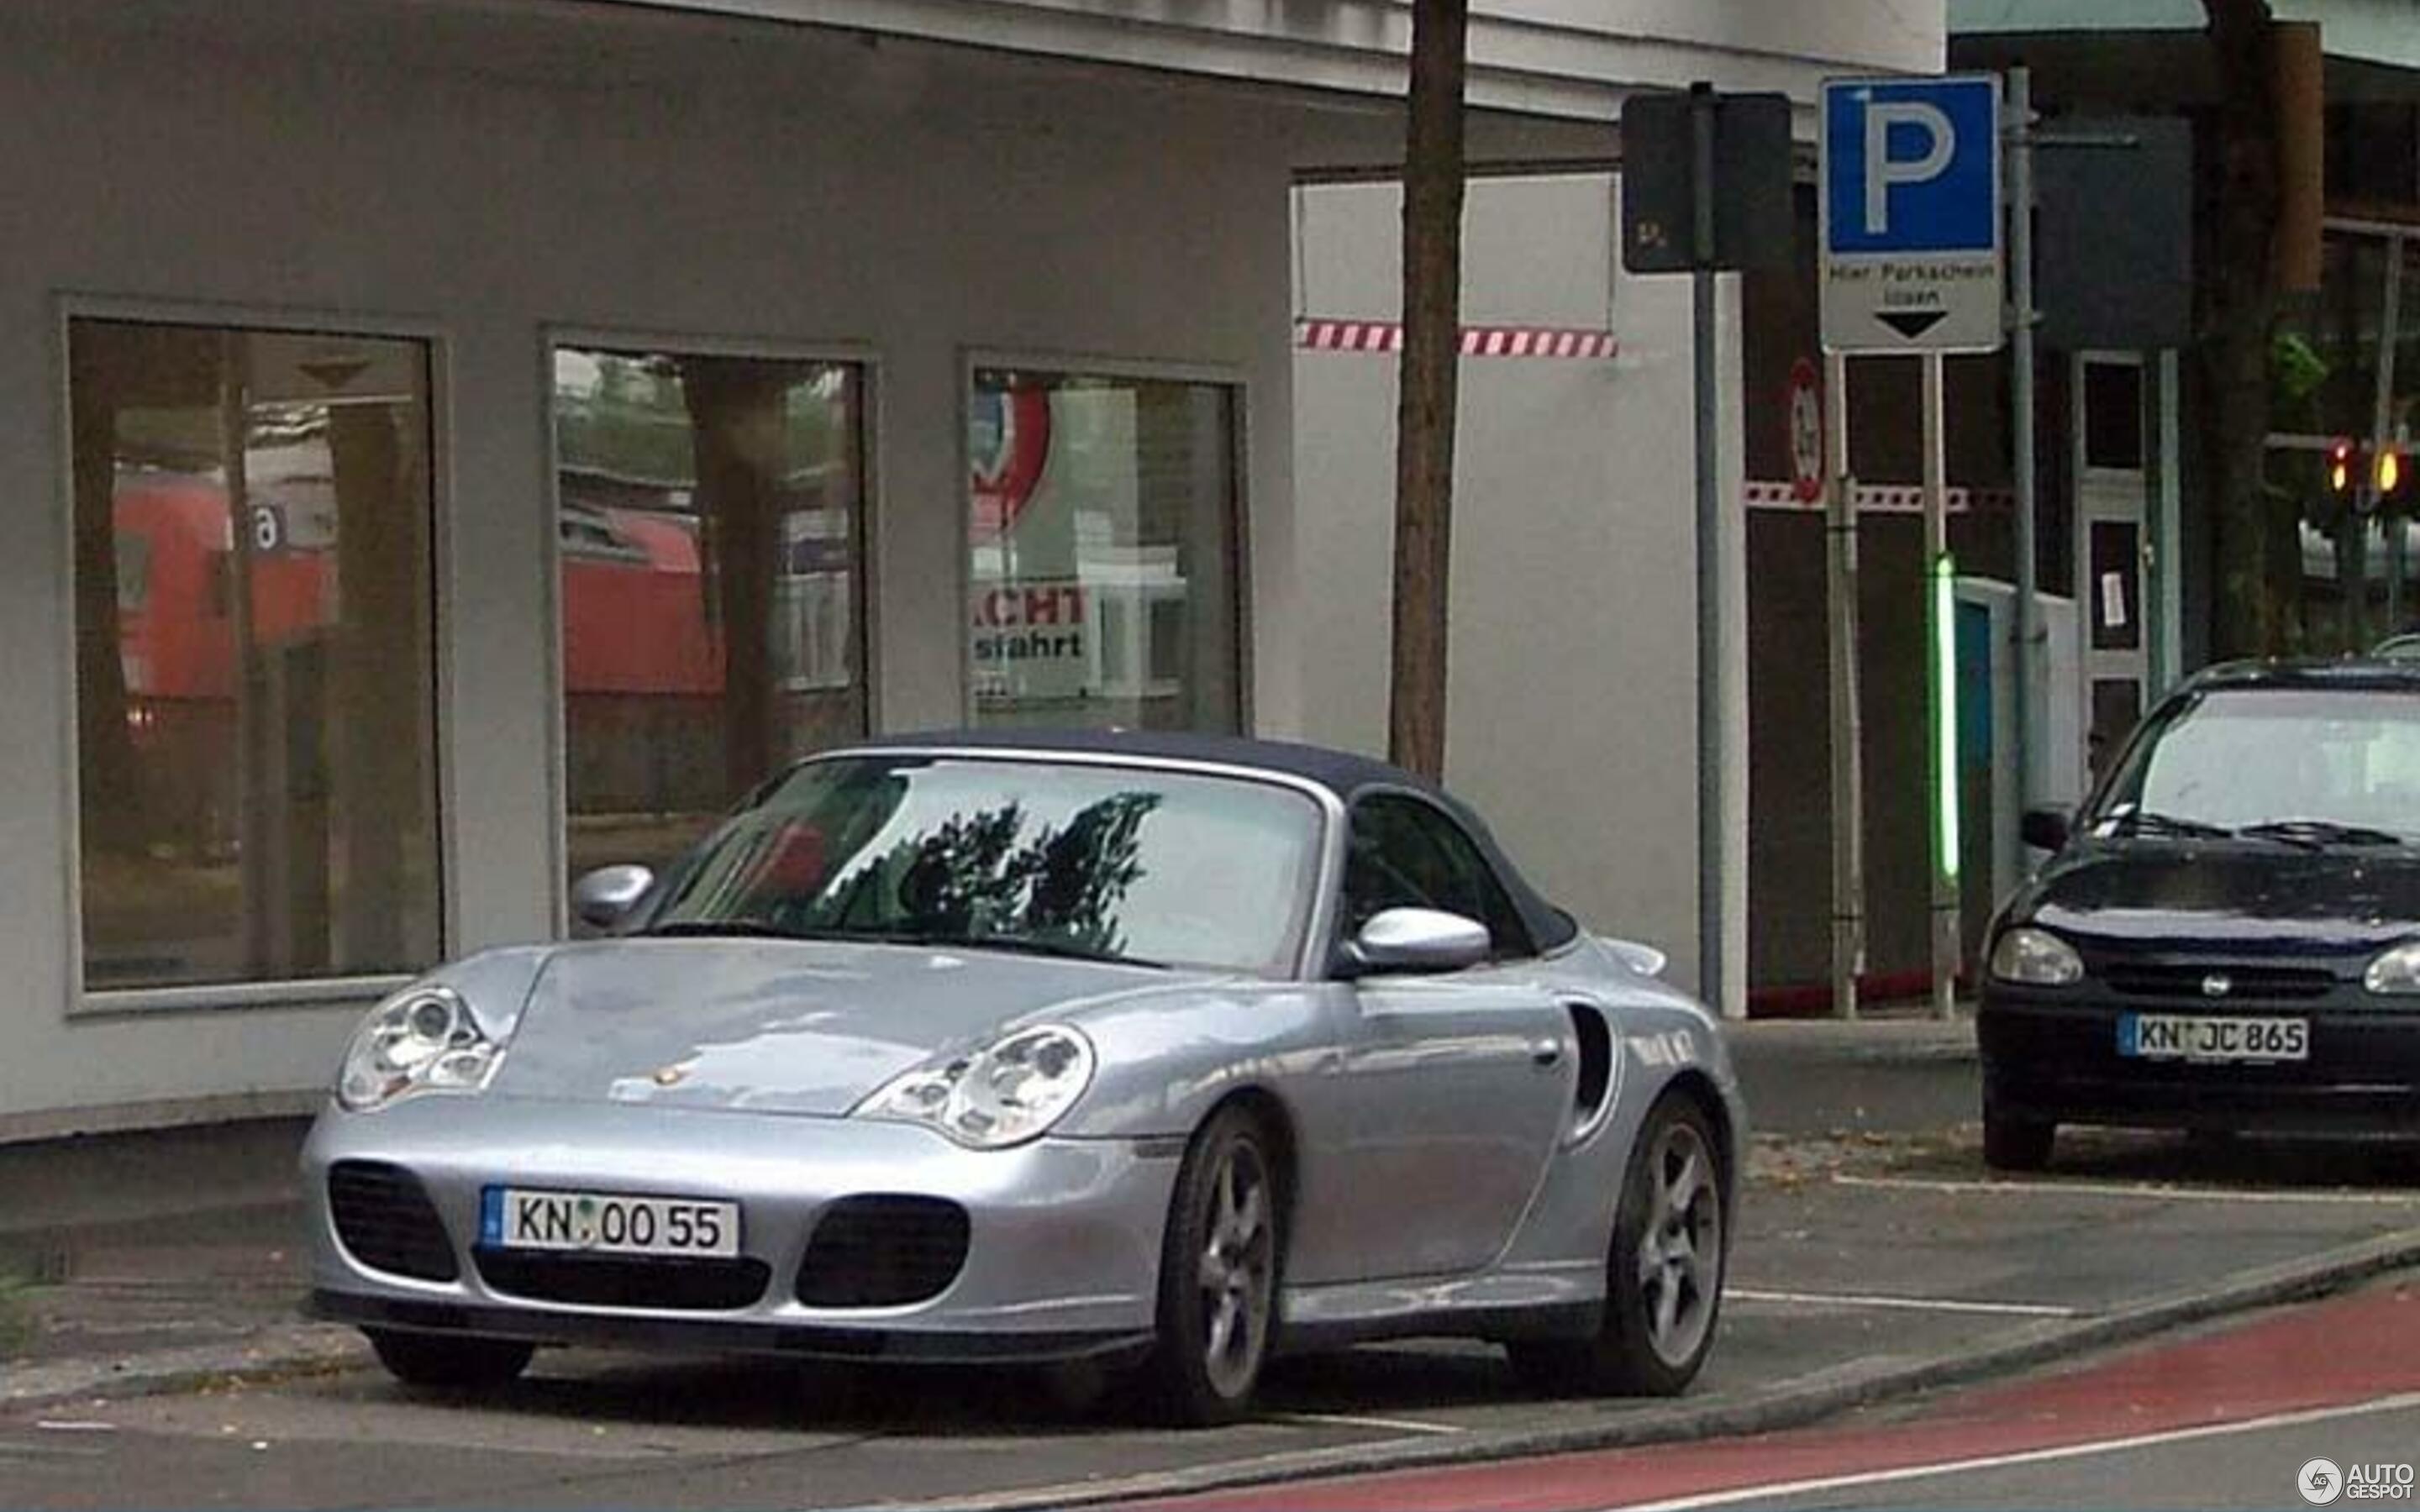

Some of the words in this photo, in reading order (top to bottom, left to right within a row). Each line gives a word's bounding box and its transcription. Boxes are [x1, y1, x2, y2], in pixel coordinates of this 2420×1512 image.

[1865, 102, 1955, 234] P
[2140, 1021, 2179, 1048] KN
[2200, 1022, 2238, 1051] JC
[2246, 1023, 2304, 1053] 865
[518, 1198, 571, 1241] KN
[668, 1206, 720, 1248] 55
